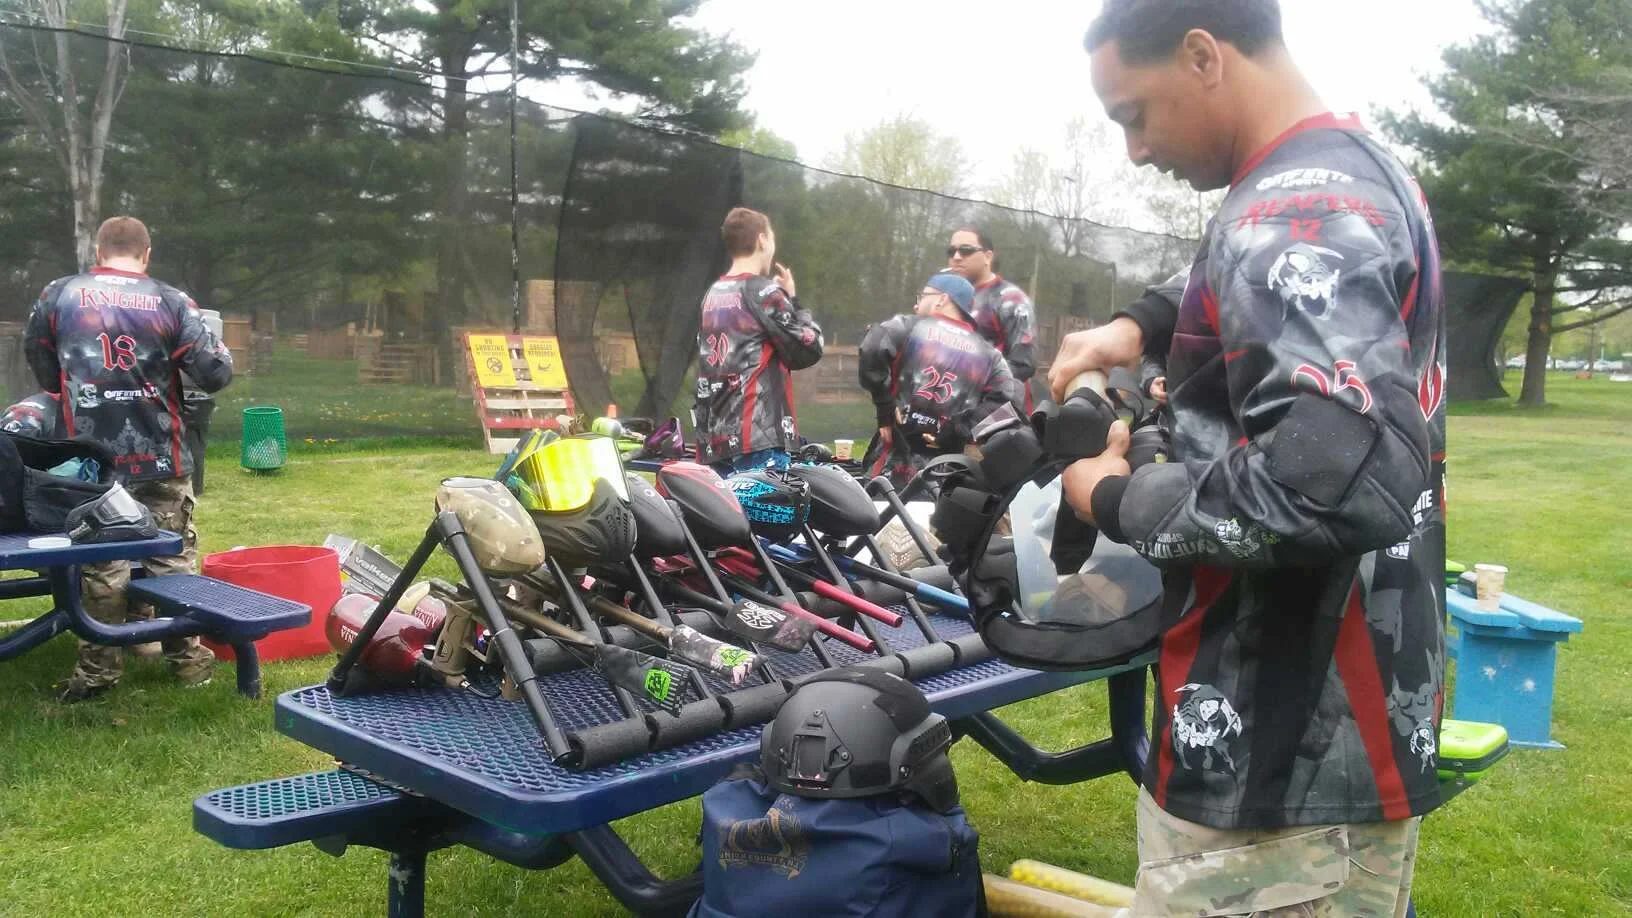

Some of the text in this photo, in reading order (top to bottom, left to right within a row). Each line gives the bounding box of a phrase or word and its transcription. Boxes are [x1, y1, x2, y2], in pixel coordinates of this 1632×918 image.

[79, 288, 162, 311] KNIGHT
[96, 332, 136, 370] 18
[706, 332, 730, 367] 30
[914, 366, 957, 404] 25
